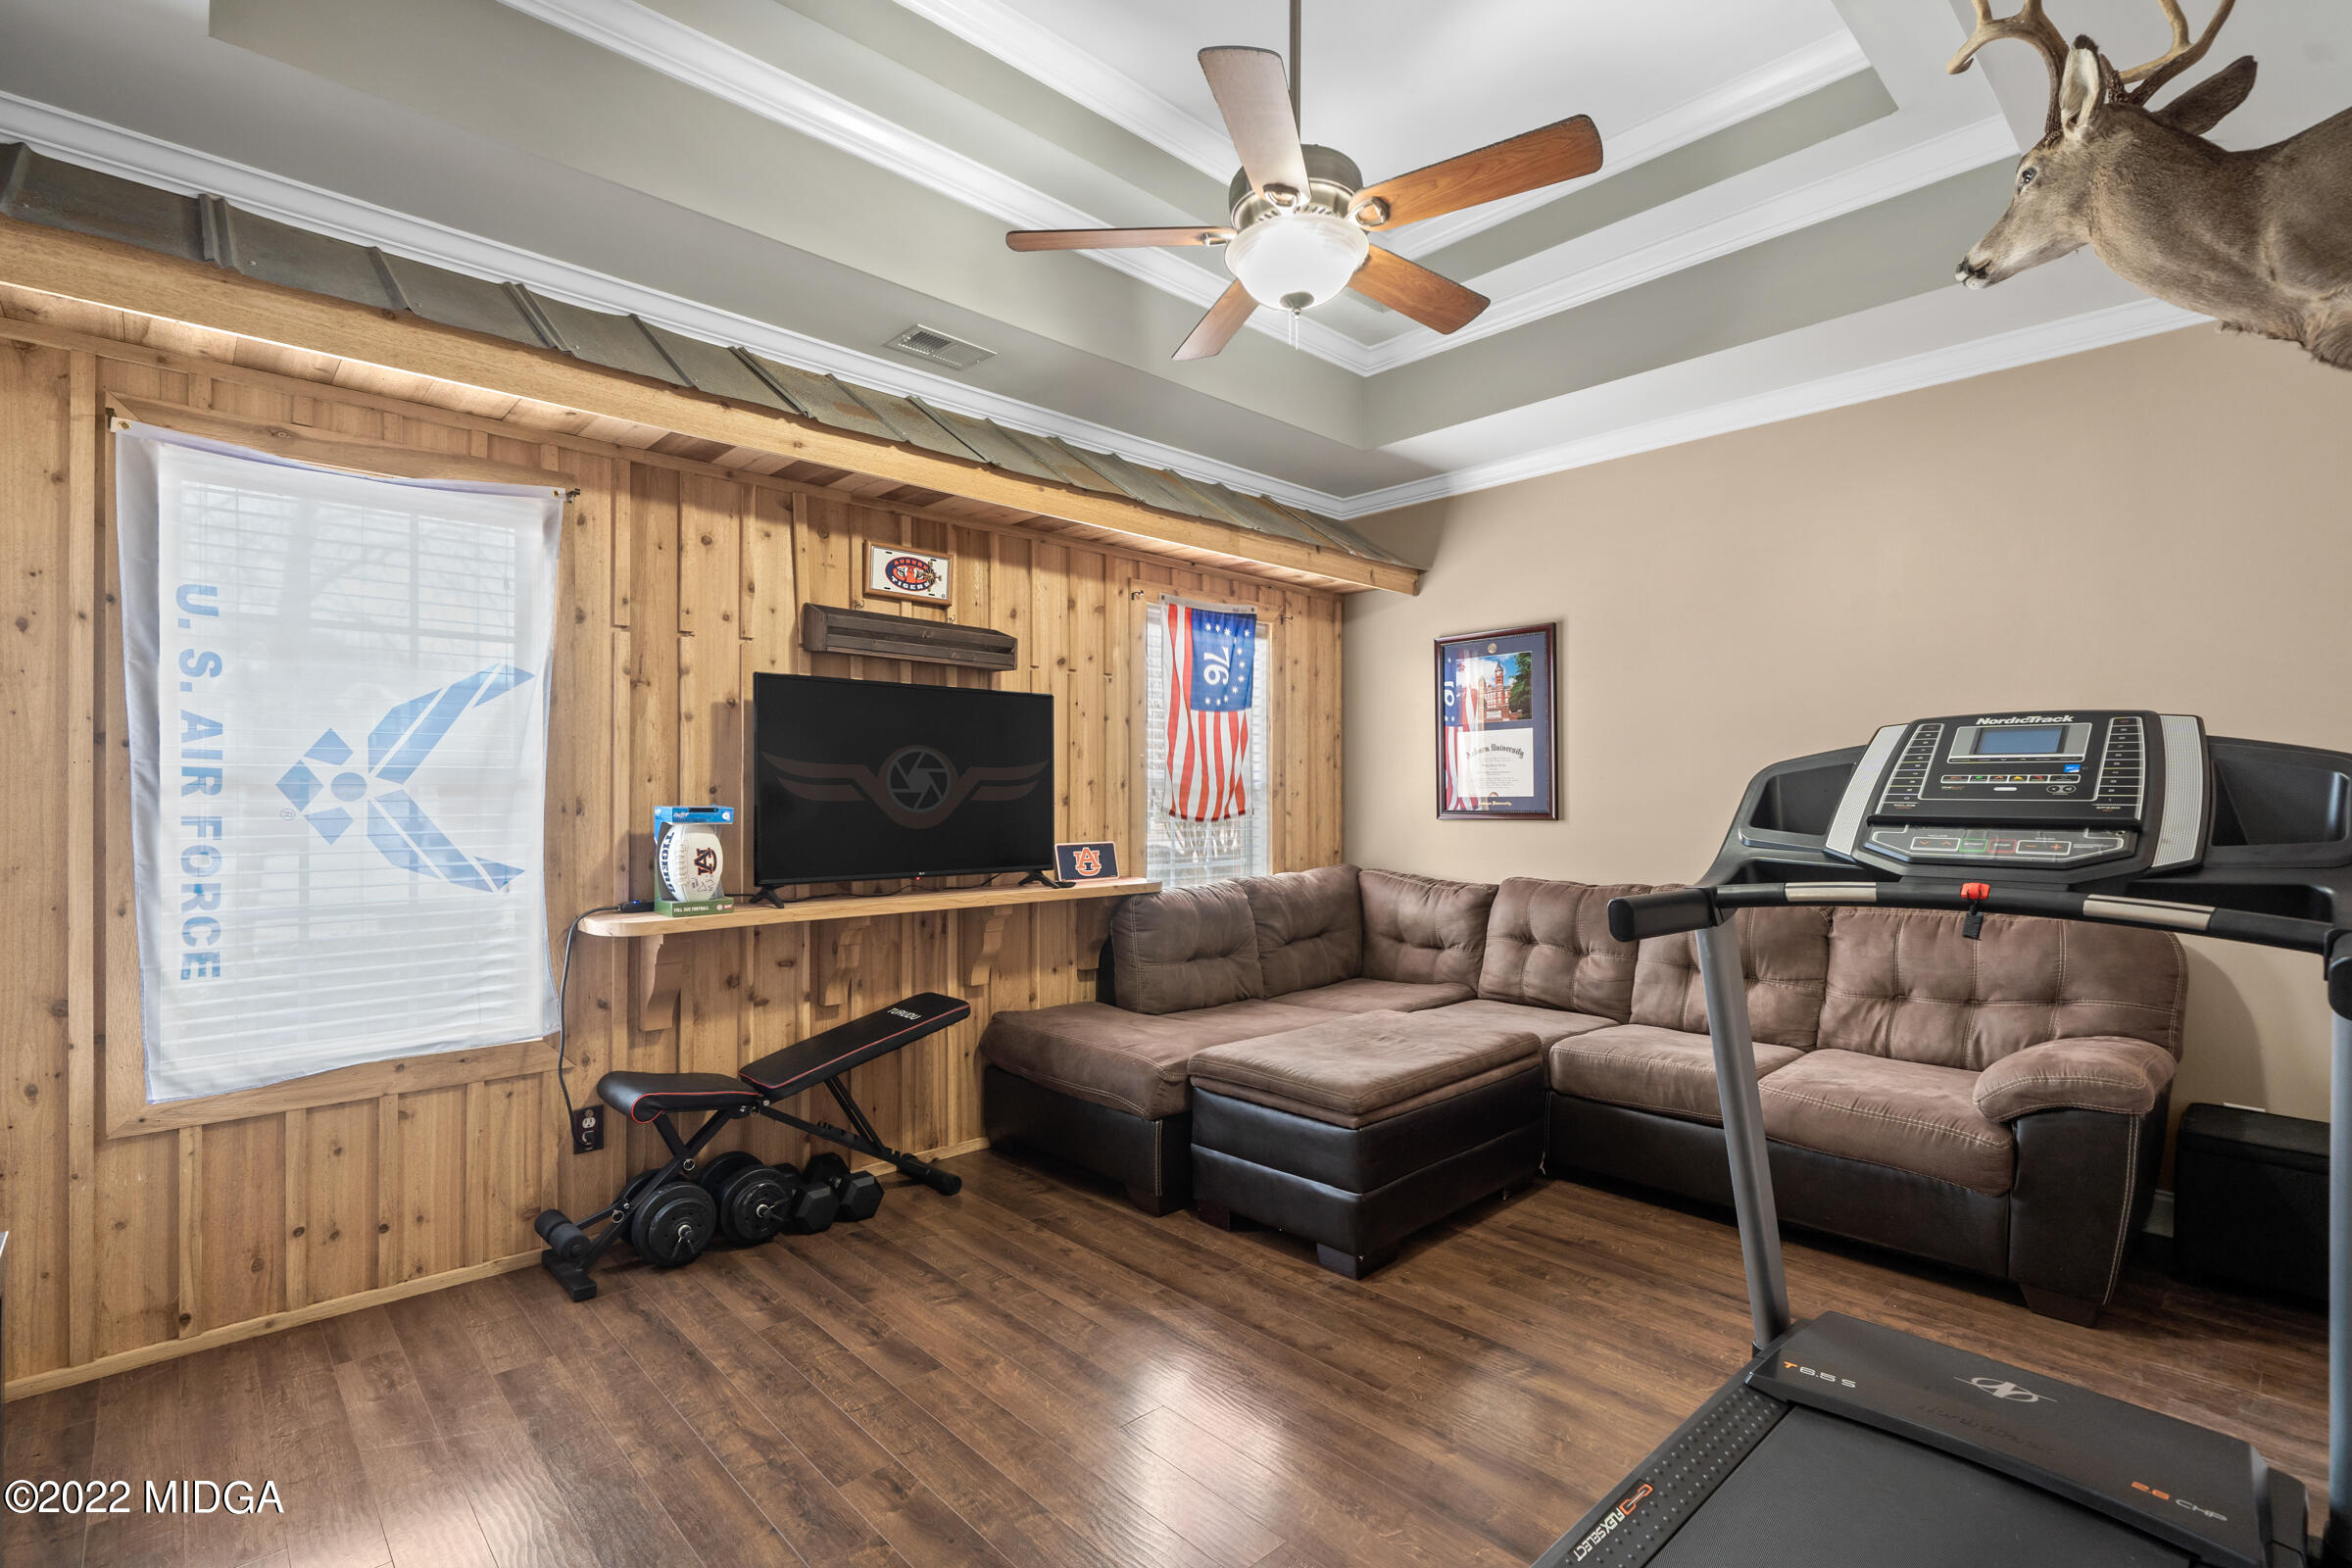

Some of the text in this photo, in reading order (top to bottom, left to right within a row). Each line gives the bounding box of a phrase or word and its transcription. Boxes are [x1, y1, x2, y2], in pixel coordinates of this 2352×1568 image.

[1203, 646, 1230, 686] 76
[1976, 714, 2075, 725] NordicTrack
[180, 709, 223, 797] AIR
[1491, 743, 1525, 760] University
[662, 832, 675, 893] TIGERS
[180, 815, 222, 981] FORCE
[2176, 1499, 2228, 1521] CHP
